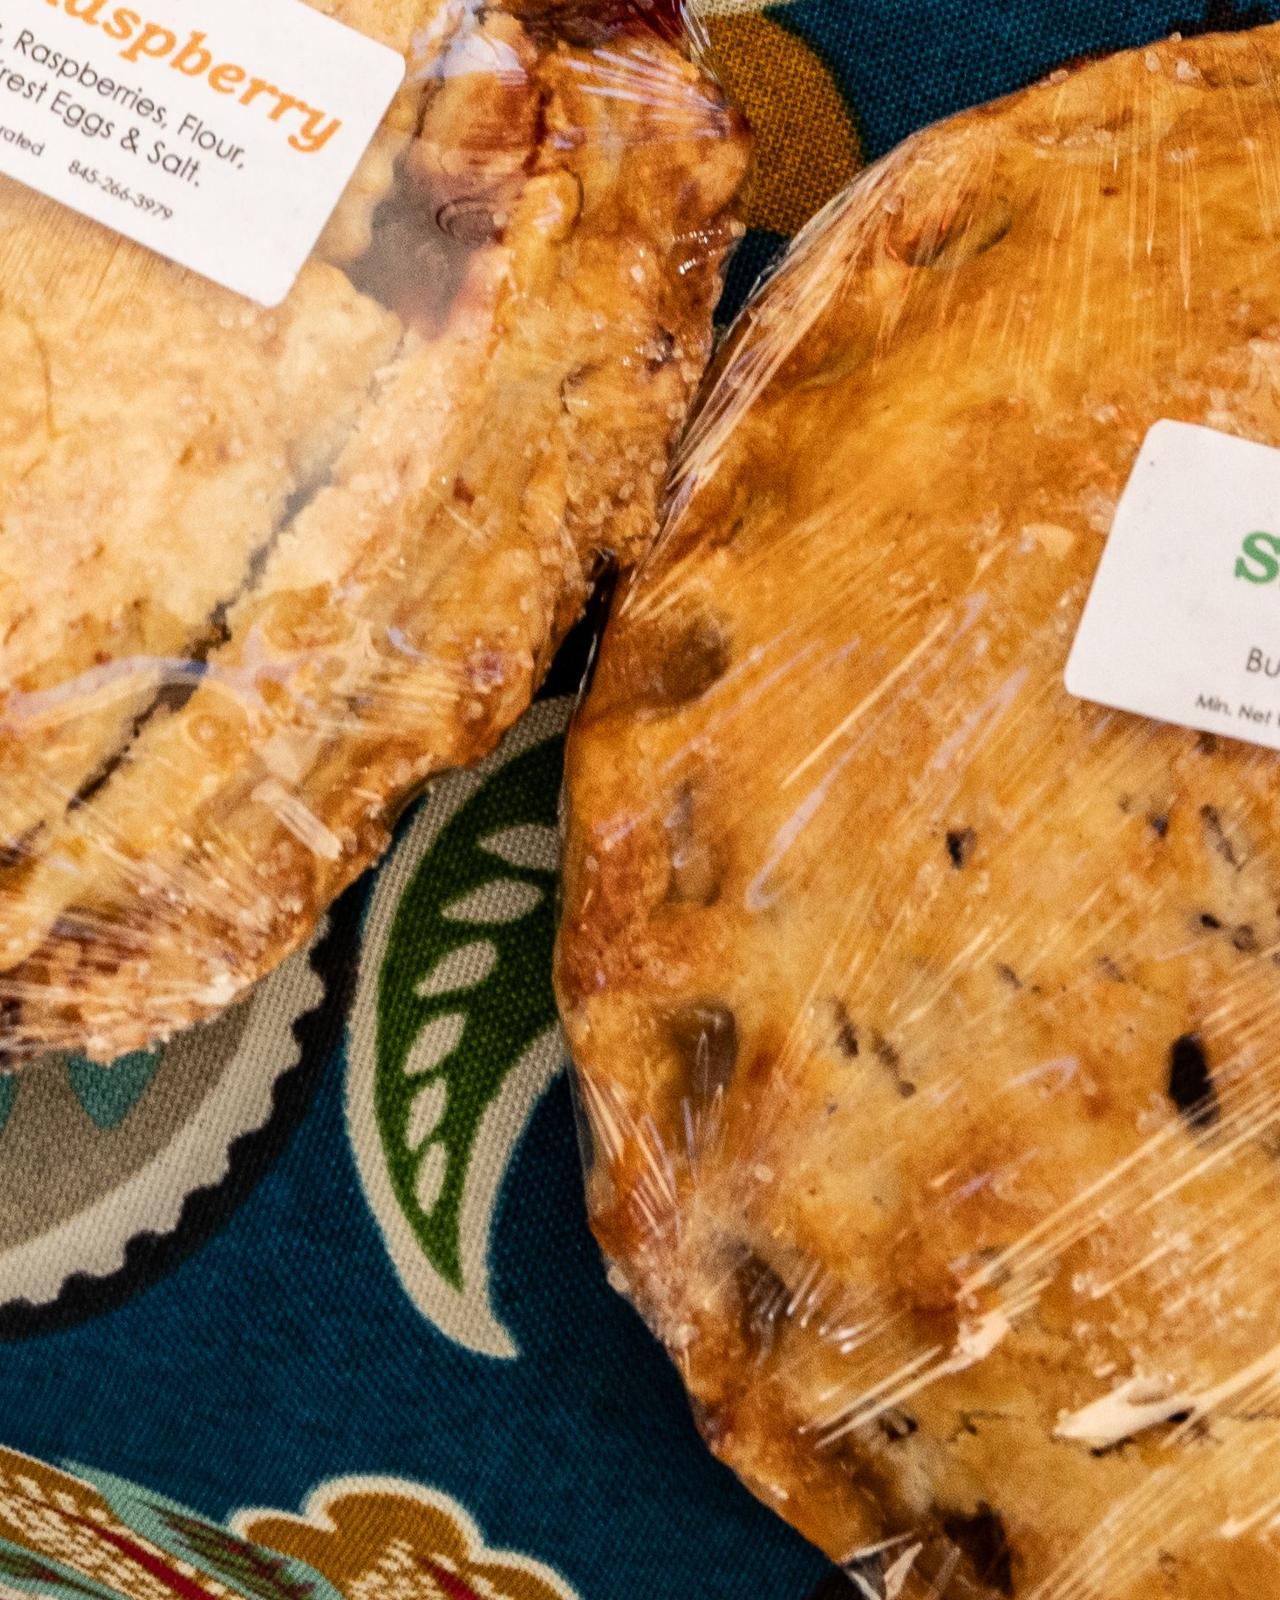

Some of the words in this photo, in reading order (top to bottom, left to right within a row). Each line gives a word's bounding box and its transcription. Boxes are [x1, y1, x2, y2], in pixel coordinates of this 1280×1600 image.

[14, 29, 168, 128] Raspberries,
[177, 113, 246, 169] Flour,
[49, 89, 115, 139] Eggs
[119, 127, 140, 155] &
[146, 140, 200, 187] Salt.
[67, 159, 174, 220] 845-266-3979
